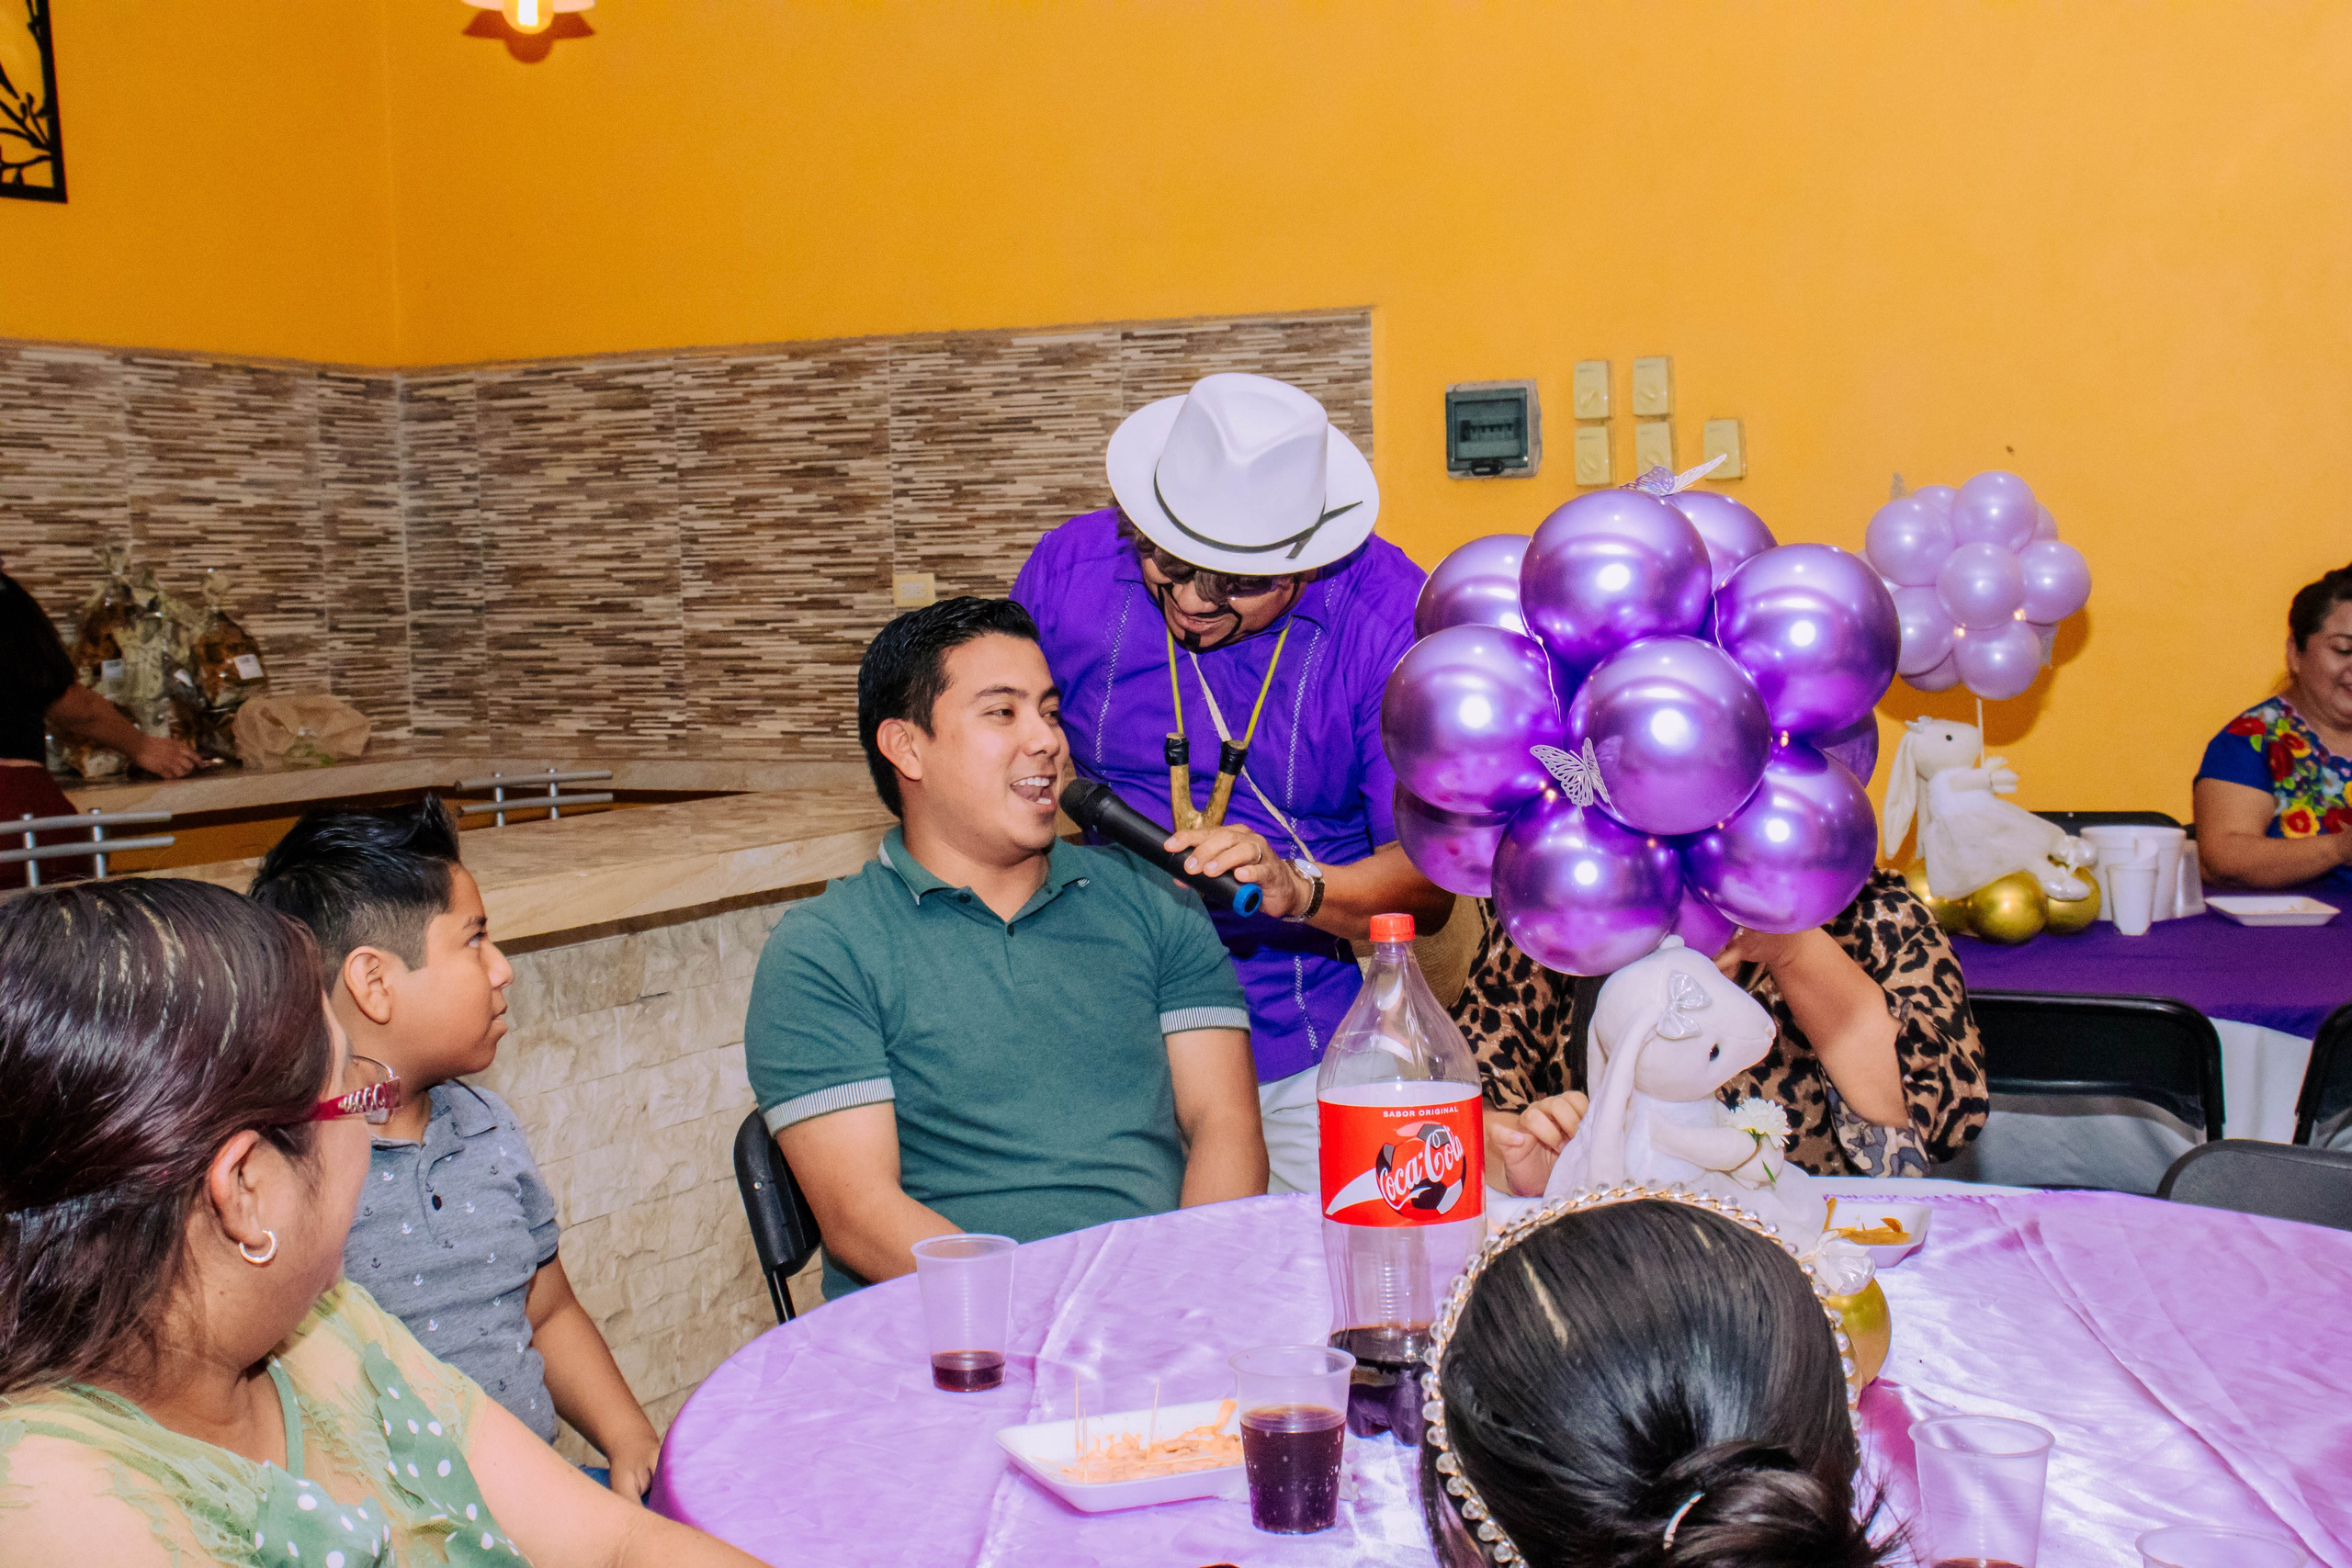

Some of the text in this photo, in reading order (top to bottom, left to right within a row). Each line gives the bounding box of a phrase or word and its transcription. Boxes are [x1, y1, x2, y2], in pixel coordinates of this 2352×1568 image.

[1383, 1105, 1459, 1118] SABOR ORIGINAL
[1380, 1124, 1464, 1211] Coca-Cola
